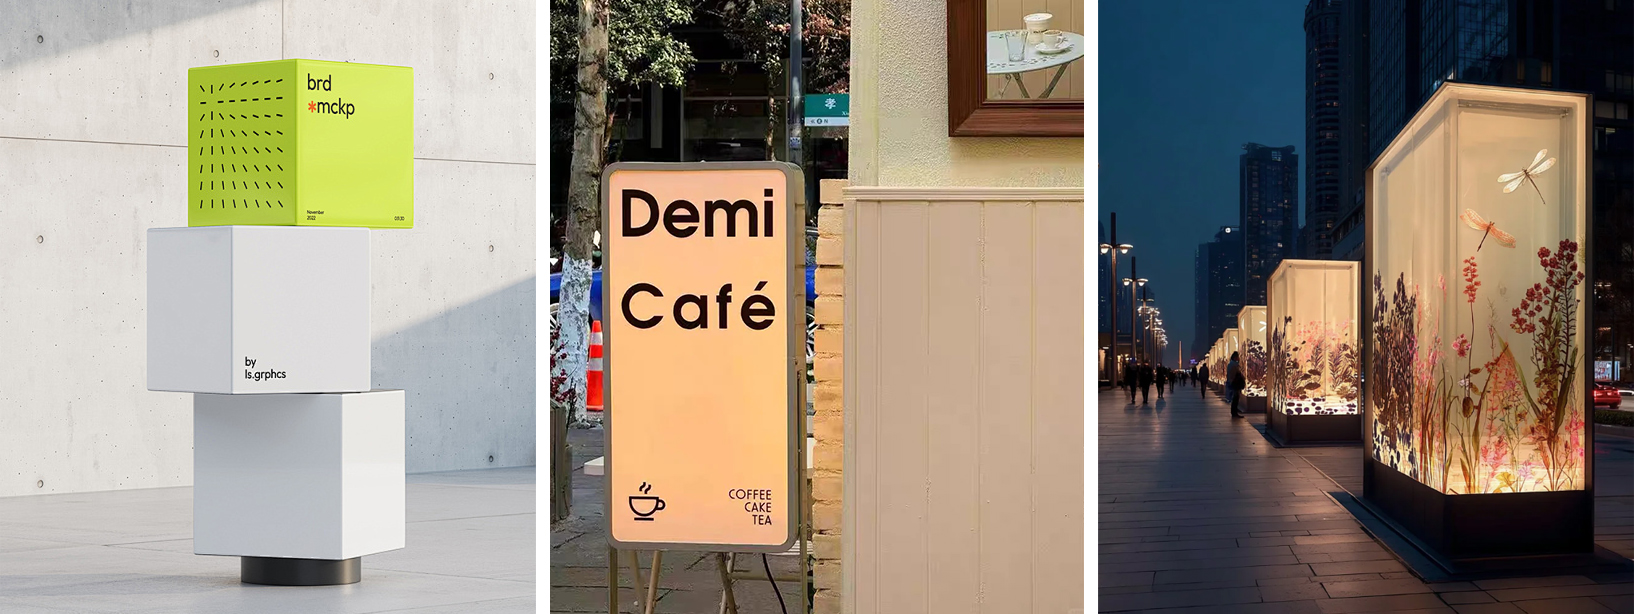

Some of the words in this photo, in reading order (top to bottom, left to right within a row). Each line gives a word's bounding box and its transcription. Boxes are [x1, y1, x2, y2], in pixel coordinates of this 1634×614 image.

[307, 73, 332, 91] brd
[621, 188, 774, 239] Demi
[621, 280, 776, 331] Café
[245, 356, 256, 368] by
[245, 369, 286, 381] ls.grphcs
[728, 489, 772, 500] COFFEE
[744, 502, 772, 512] CAKE
[752, 514, 772, 525] TEA
